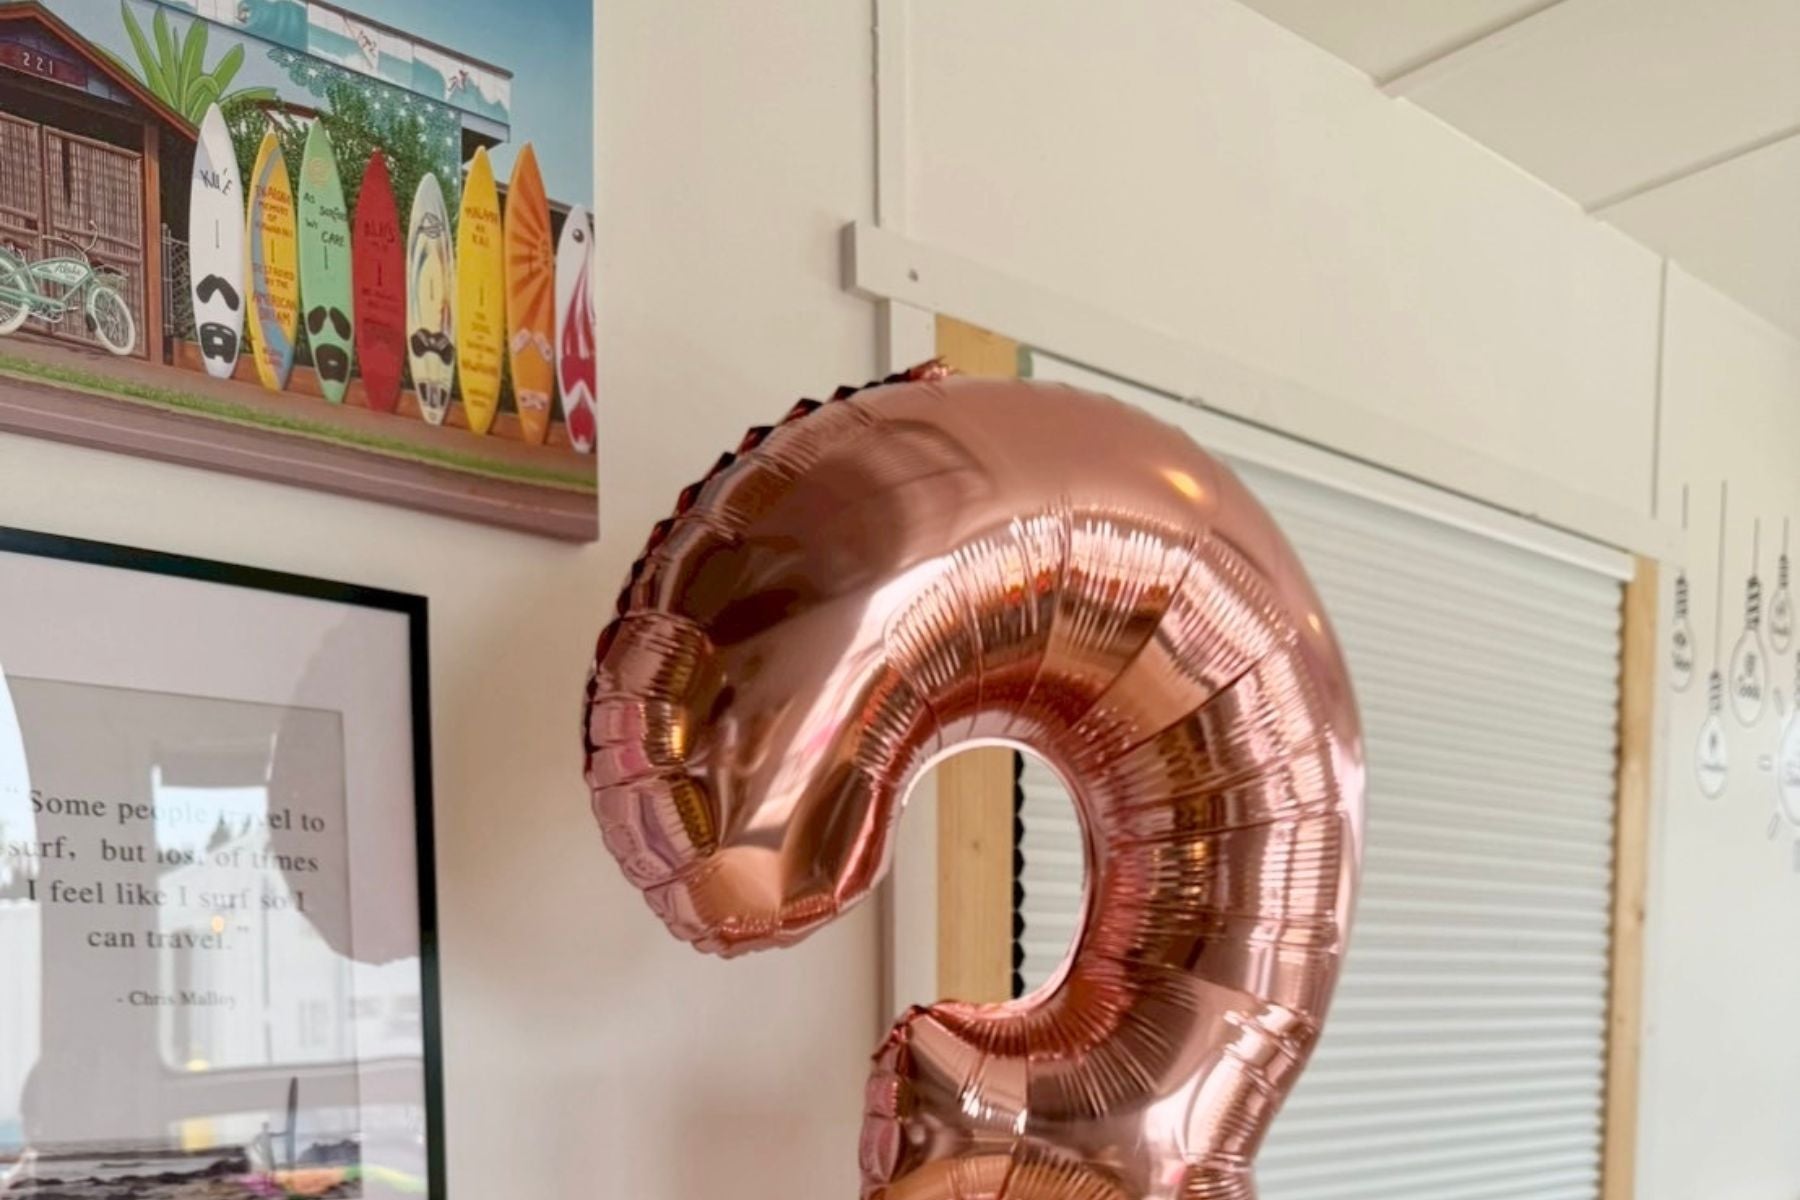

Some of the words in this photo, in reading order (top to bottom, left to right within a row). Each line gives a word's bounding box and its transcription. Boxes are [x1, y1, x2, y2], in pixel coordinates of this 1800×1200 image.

[22, 51, 53, 74] 221
[302, 813, 325, 832] to
[101, 838, 145, 863] but
[215, 847, 246, 868] of
[27, 878, 36, 901] I
[51, 880, 105, 904] feel
[116, 882, 168, 906] like
[200, 888, 251, 910] surf
[87, 931, 136, 948] can
